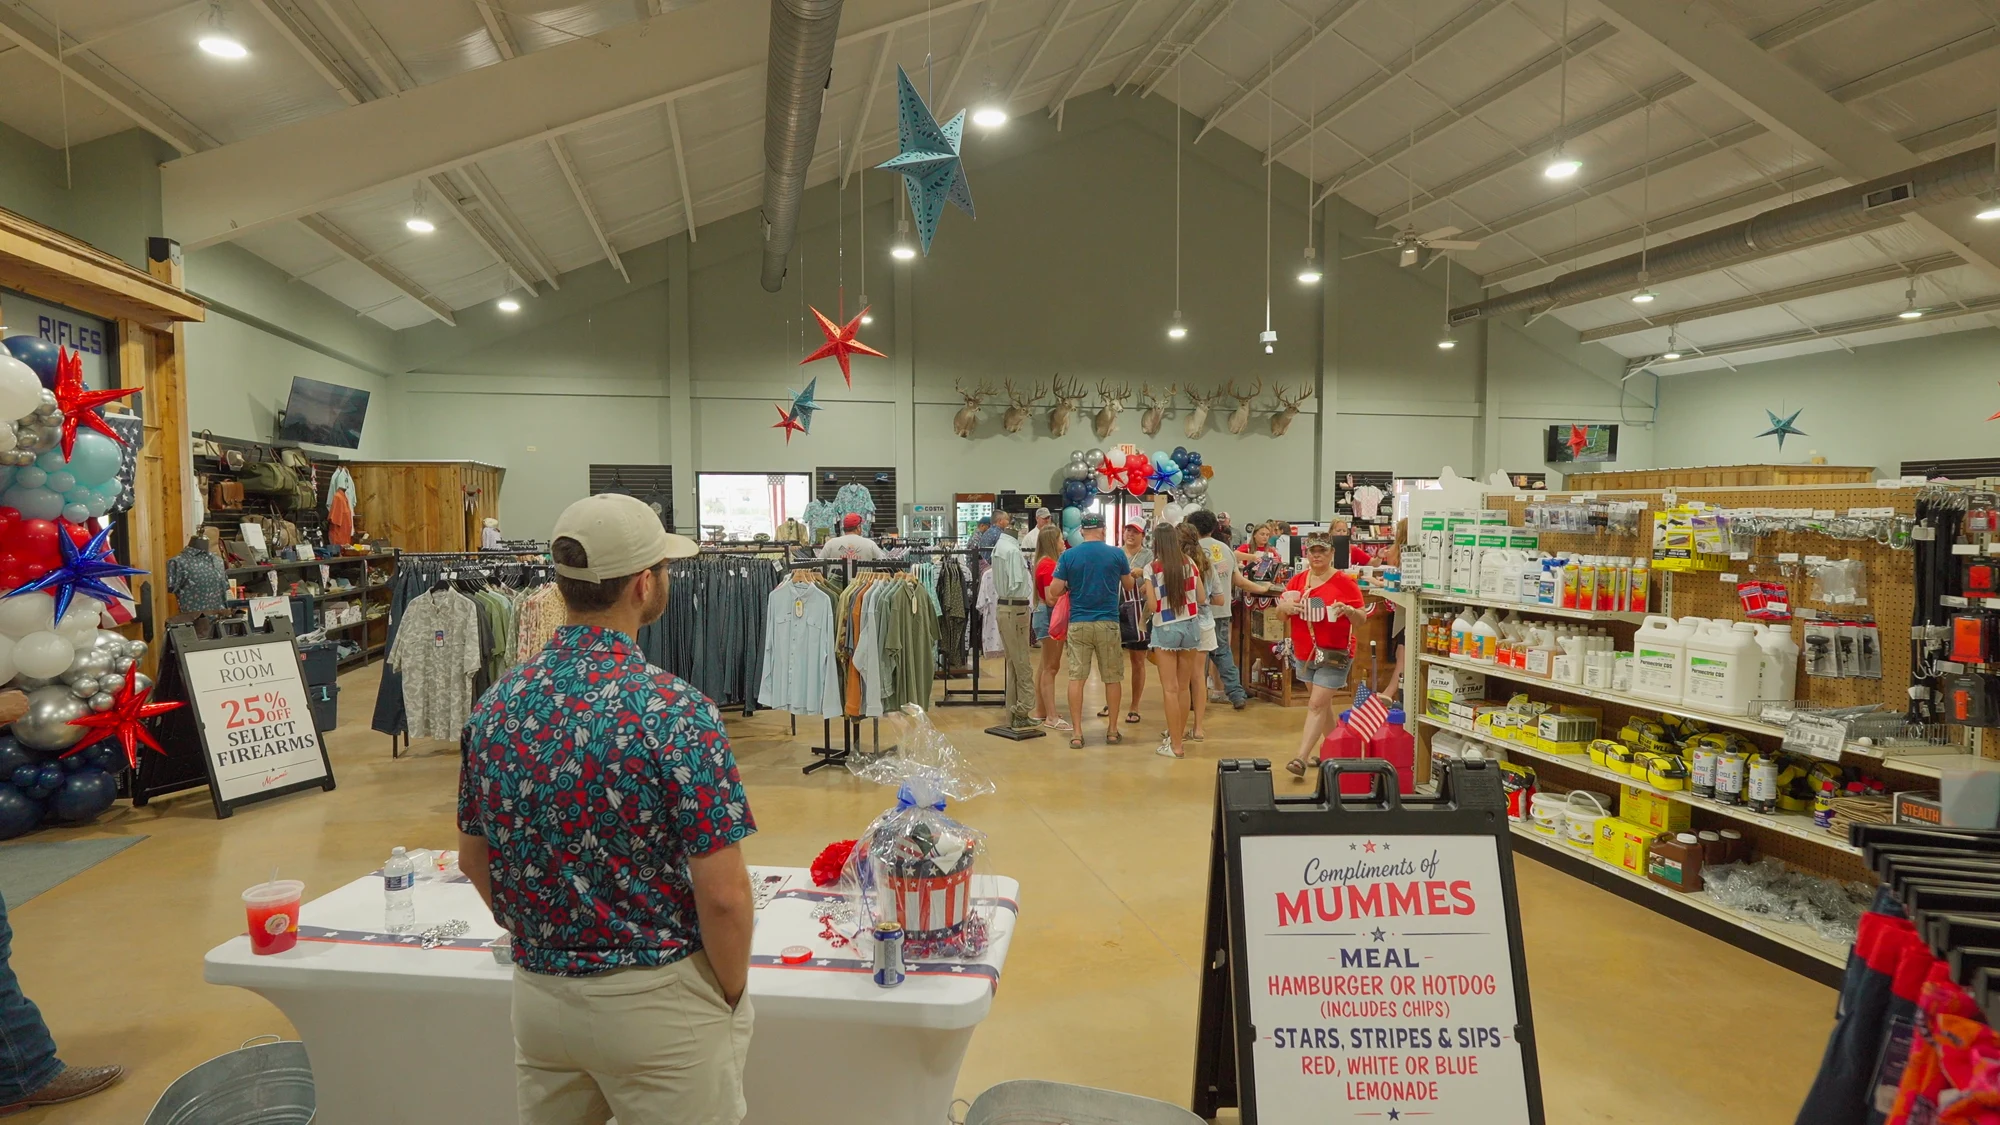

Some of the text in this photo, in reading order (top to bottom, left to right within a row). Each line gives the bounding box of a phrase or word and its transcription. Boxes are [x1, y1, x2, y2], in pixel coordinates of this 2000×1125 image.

[39, 315, 101, 355] RIFLES
[223, 648, 263, 666] GUN
[219, 663, 275, 683] ROOM
[220, 690, 287, 729] 25%
[266, 708, 292, 722] OFF
[228, 720, 296, 747] SELECT
[216, 734, 315, 767] FIREARMS
[1902, 802, 1939, 822] STEALTH
[1304, 850, 1439, 886] Compliments of
[1274, 880, 1476, 928] MUMMES
[1340, 948, 1420, 968] MEAL
[1268, 974, 1496, 996] HAMBURGER OR HOTDOG
[1320, 1000, 1450, 1019] (INCLUDES CHIPS)
[1274, 1027, 1501, 1051] STARS, STRIPES & SIPS
[1302, 1056, 1478, 1078] RED, WHITE OR BLUE
[1346, 1081, 1439, 1102] LEMONADE
